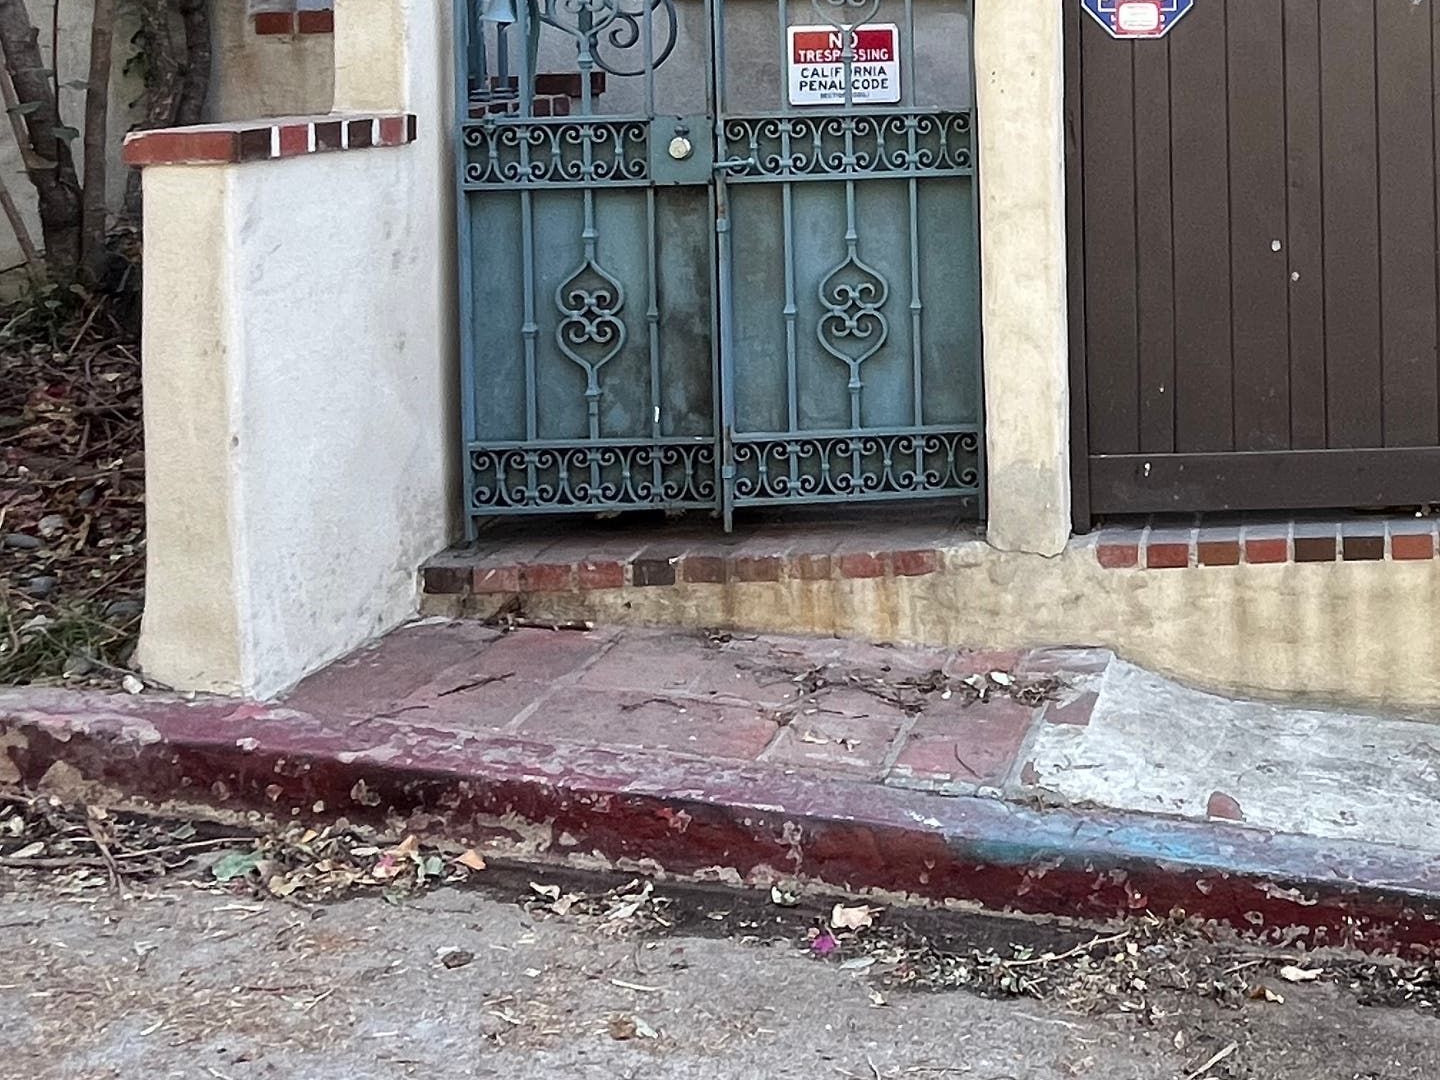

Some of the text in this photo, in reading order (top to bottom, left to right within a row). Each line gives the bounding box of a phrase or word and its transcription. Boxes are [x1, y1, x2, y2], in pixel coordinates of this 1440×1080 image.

[799, 48, 889, 62] TRESPSSING
[801, 65, 887, 78] CALIFRNIA
[799, 78, 888, 91] PENAL CODE
